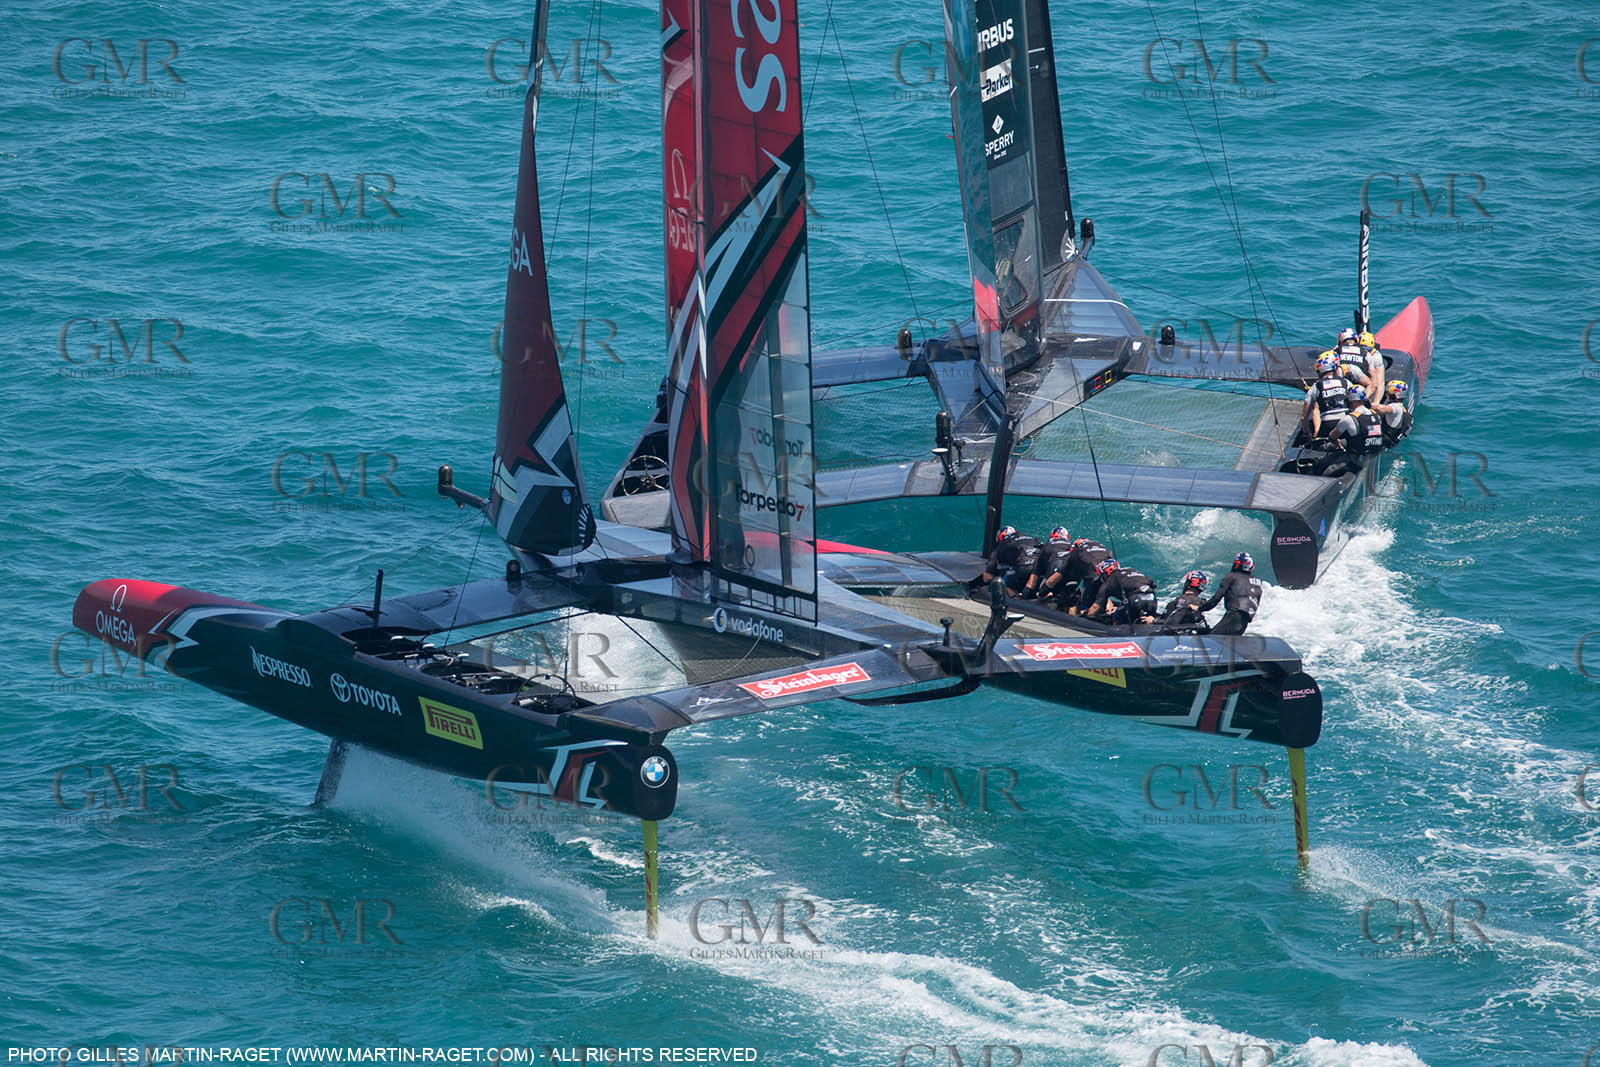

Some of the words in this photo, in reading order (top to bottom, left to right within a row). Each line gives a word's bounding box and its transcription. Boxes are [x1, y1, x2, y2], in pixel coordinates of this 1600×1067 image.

[977, 18, 1014, 53] IRBUS
[985, 130, 1014, 156] SPERRY
[96, 610, 137, 647] OMEGA
[731, 616, 784, 643] vodafone
[250, 645, 312, 688] NESPRESSO
[1033, 644, 1137, 660] Steinlager
[757, 666, 861, 697] Steinlager
[1282, 689, 1316, 697] BERMUDA
[350, 683, 402, 716] TOYOTA
[426, 704, 477, 740] PIRELLI
